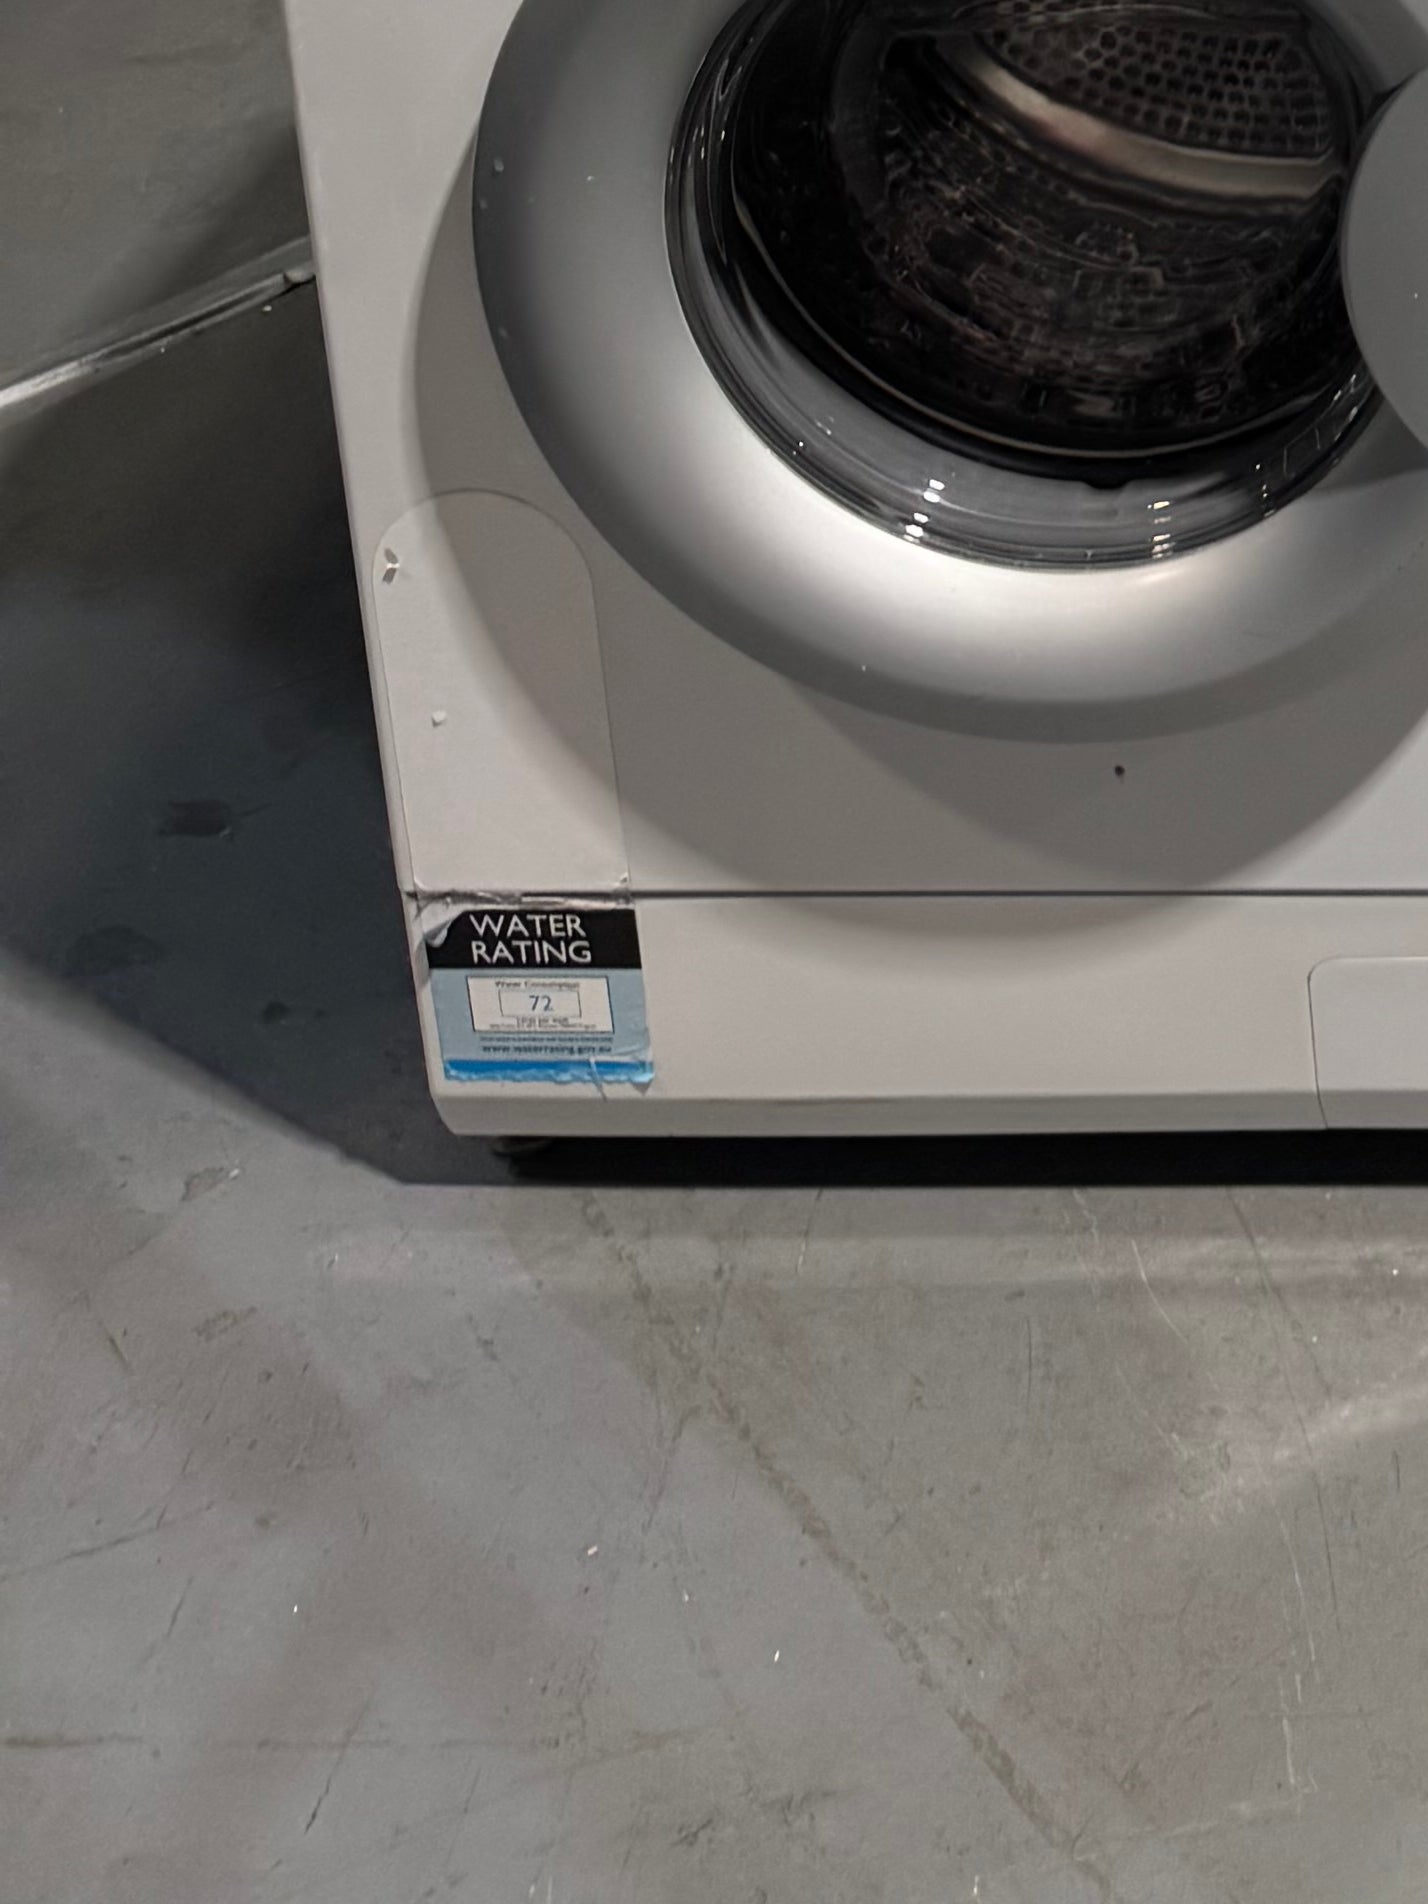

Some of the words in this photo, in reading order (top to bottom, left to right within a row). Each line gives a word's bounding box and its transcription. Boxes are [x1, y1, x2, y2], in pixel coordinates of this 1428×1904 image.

[469, 913, 587, 938] WATER
[470, 940, 592, 965] RATING
[528, 994, 554, 1012] 72
